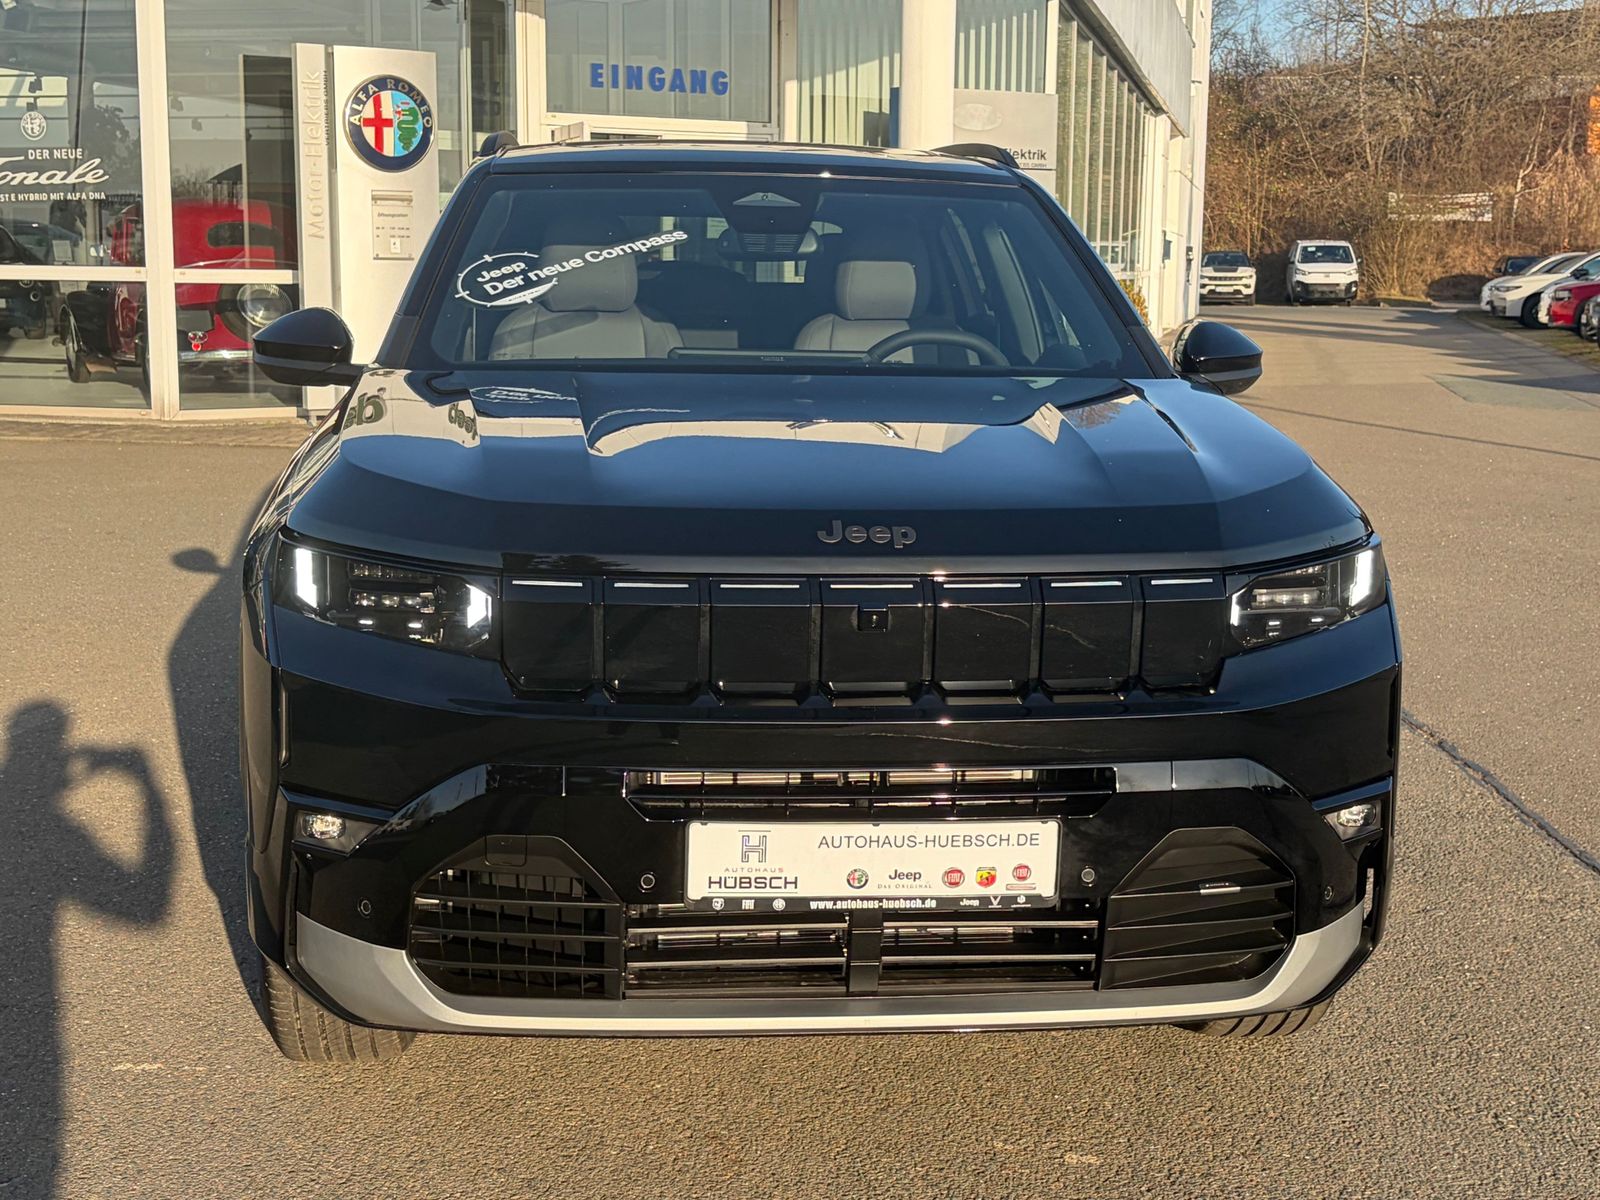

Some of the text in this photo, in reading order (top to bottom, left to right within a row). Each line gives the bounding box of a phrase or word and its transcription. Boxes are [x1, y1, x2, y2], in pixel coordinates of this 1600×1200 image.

[590, 63, 729, 96] EINGANG
[350, 78, 432, 128] ALFA ROMEO
[28, 148, 83, 159] DER NEUE
[18, 193, 48, 201] HYBRID
[50, 192, 64, 200] MIT
[67, 192, 87, 200] ALFA
[89, 192, 106, 200] DNA
[483, 230, 688, 296] Der neue Compass
[476, 261, 528, 283] Jeep
[817, 519, 917, 549] Jeep
[818, 833, 1040, 849] AUTOHAUS-HUEBSCH.DE
[708, 876, 798, 889] HÜBSCH
[888, 869, 922, 881] Jeep
[809, 898, 937, 910] www.autohaus-huebsch.de
